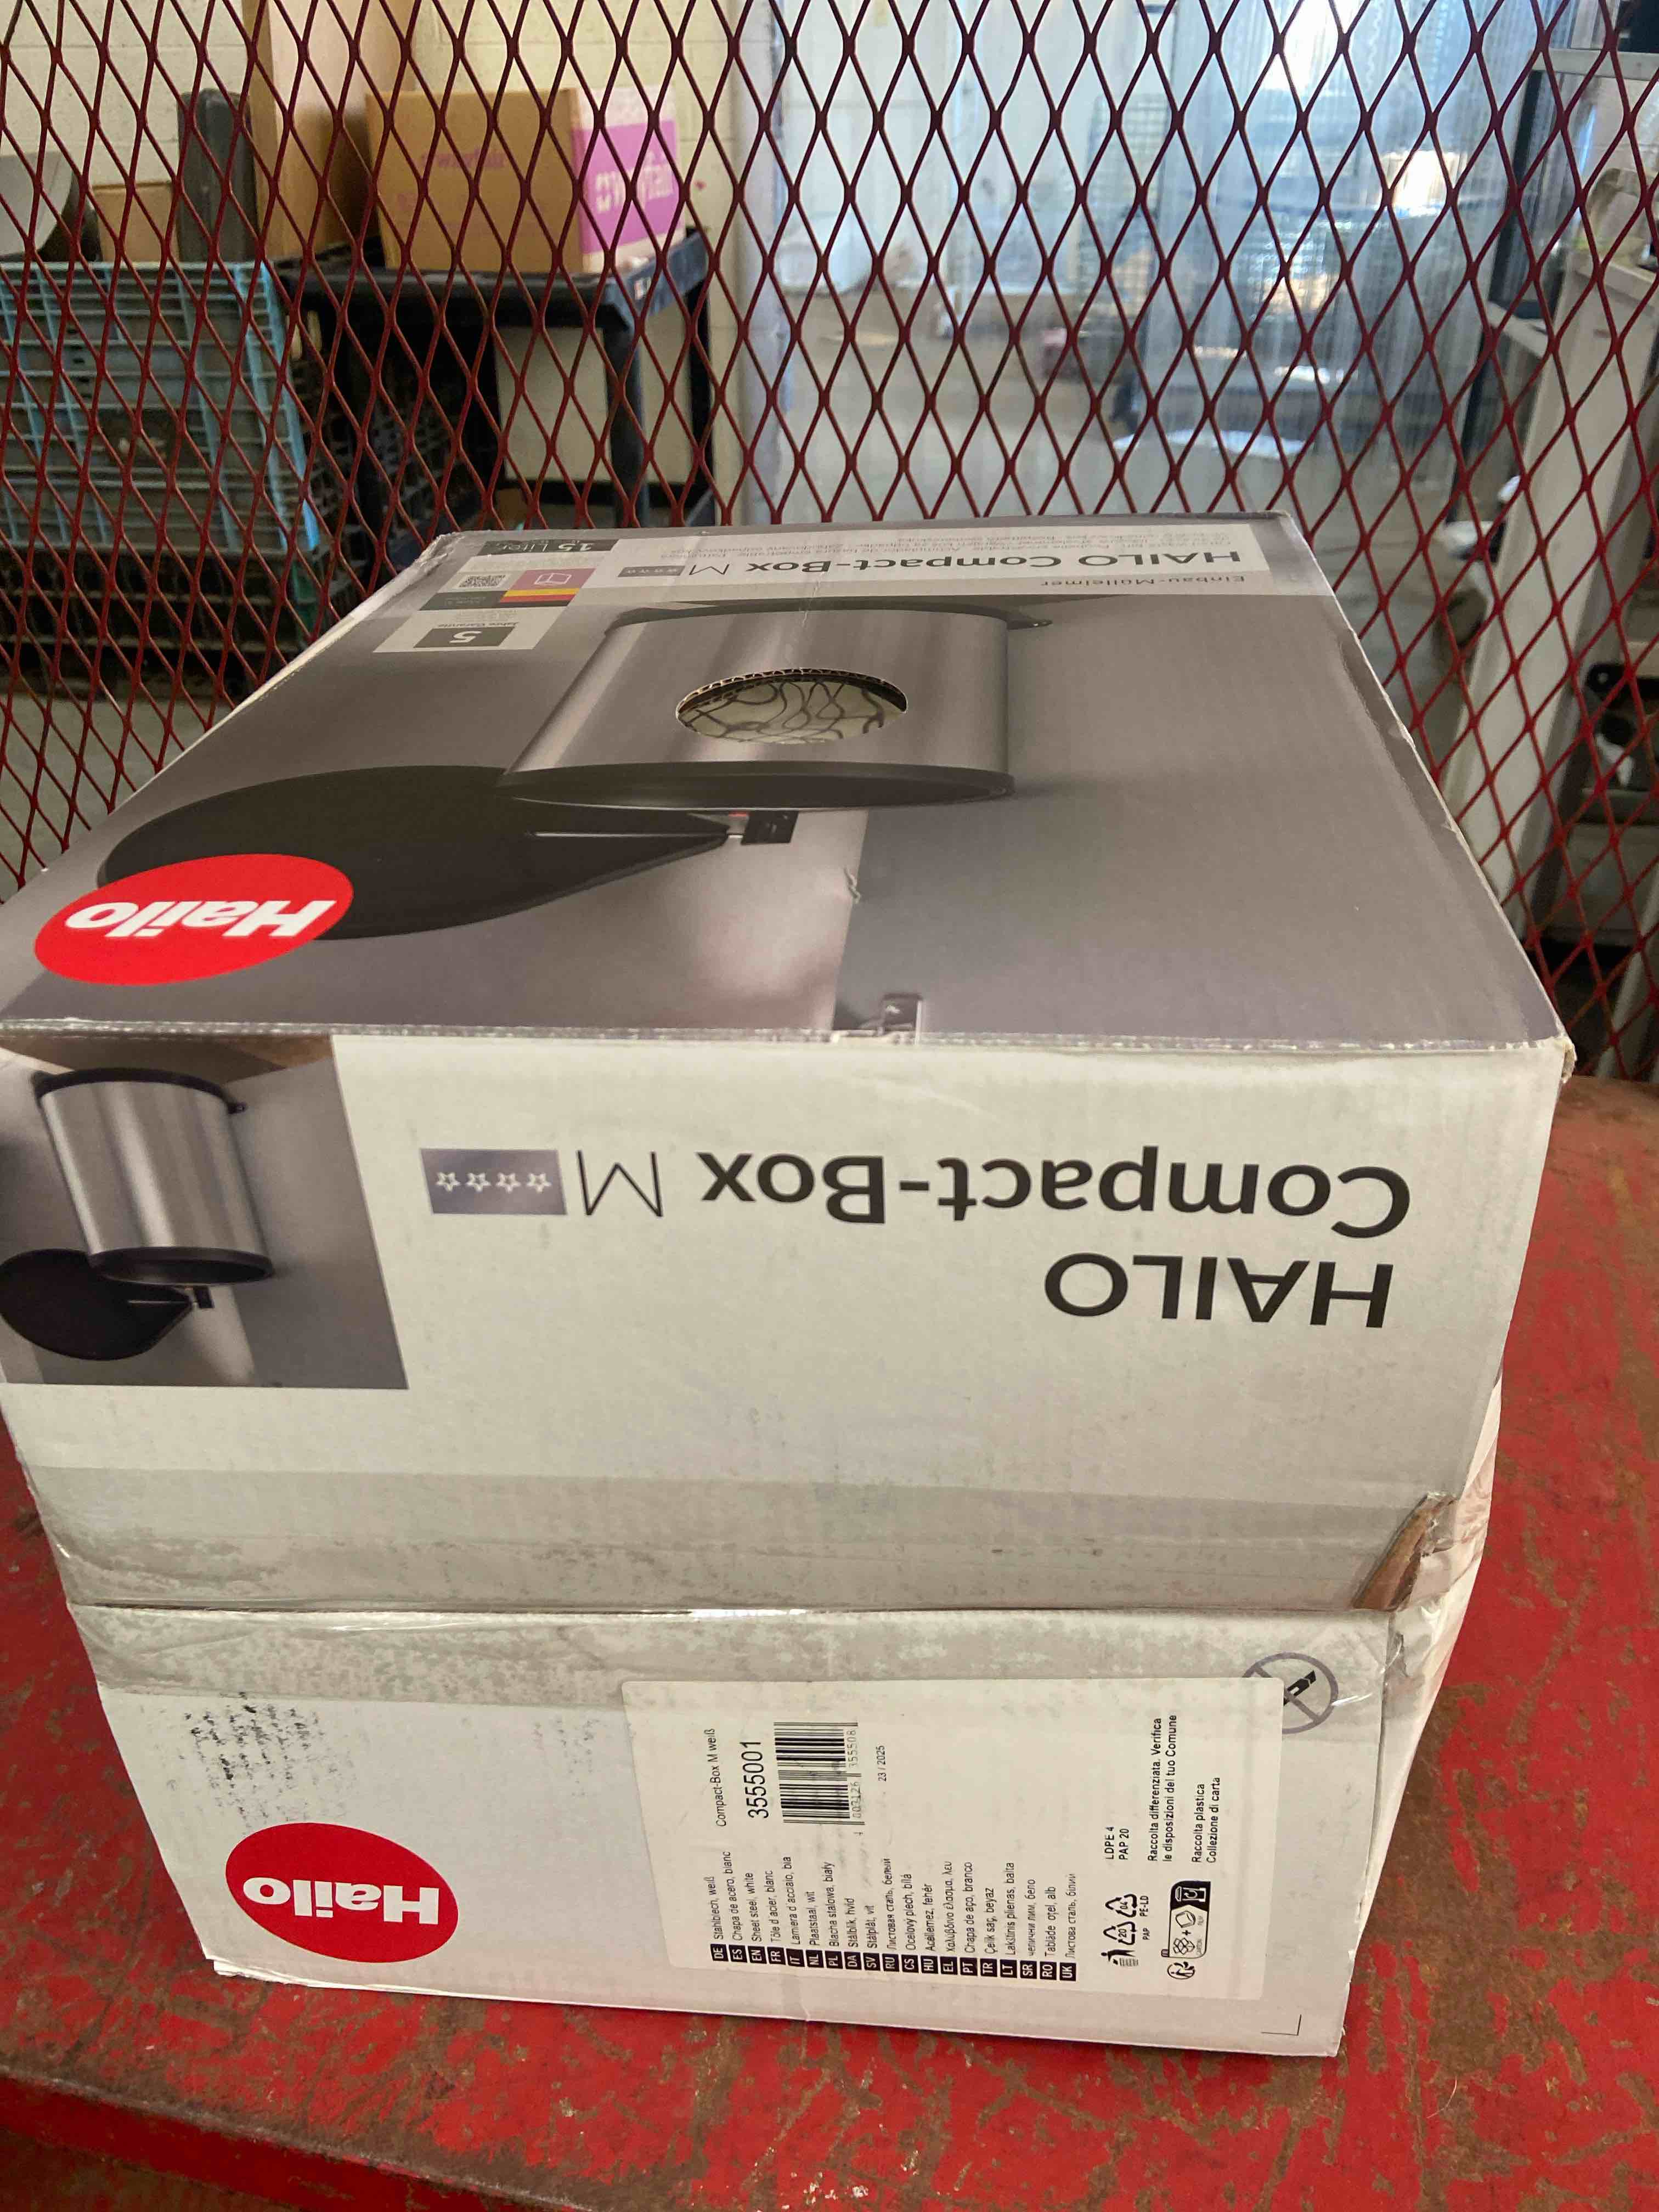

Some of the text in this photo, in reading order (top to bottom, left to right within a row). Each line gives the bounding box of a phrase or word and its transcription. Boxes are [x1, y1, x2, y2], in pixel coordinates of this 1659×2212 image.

[558, 543, 594, 552] 15
[688, 550, 1241, 576] HAILO Compact-Box M
[1040, 575, 1245, 587] Einbau-Mülleimer
[449, 631, 483, 644] 5
[65, 900, 336, 938] Hailo
[579, 1150, 1410, 1239] Compact-Box M
[1044, 1252, 1393, 1328] HAILO
[846, 1730, 859, 1767] 355508
[876, 1745, 885, 1765] 2025
[703, 1728, 727, 1826] Compact-Box M weiß
[739, 1741, 769, 1818] 3555001
[878, 1771, 887, 1781] 23
[1148, 1717, 1162, 1861] Raccolta differenziata. Verifica
[1163, 1714, 1177, 1861] le disposizioni del tuo Comune
[1192, 1783, 1206, 1862] Raccolta plastica
[1206, 1777, 1220, 1863] Collezione di carta
[1104, 1833, 1114, 1859] LDPE
[1119, 1828, 1129, 1860] PAP 20
[743, 1872, 755, 1894] white
[764, 1869, 775, 1892] blanc
[1003, 1862, 1014, 1883] balta
[805, 1891, 815, 1903] wit
[885, 1888, 895, 1911] сталь,
[922, 1883, 933, 1905] fehér
[984, 1887, 997, 1912] beyaz
[1024, 1878, 1036, 1899] бело
[1044, 1886, 1056, 1899] alb
[242, 1876, 439, 1925] Hailo
[722, 1851, 743, 1960] ES Chapa de acero, blanc
[844, 1897, 855, 1915] hvid
[865, 1904, 874, 1914] vit
[1003, 1886, 1017, 1919] plienas,
[1067, 1899, 1077, 1923] сталь,
[1139, 1895, 1149, 1917] PE-LD
[703, 1875, 724, 1959] DE Stahlblech, weiß
[822, 1861, 839, 1966] PL Blacha stalowa, biały
[900, 1874, 917, 1970] CS Ocelový plech, bílá
[962, 1861, 977, 1973] PT Chapa de aço, branco
[749, 1919, 762, 1942] Sheet
[769, 1926, 781, 1943] Tôle
[787, 1913, 800, 1945] Lamiera
[887, 1914, 897, 1950] Листовая
[1119, 1928, 1127, 1938] 20
[1142, 1927, 1150, 1940] PAP
[984, 1934, 998, 1954] Çelik
[1065, 1926, 1076, 1959] Листова
[751, 1949, 762, 1961] EN
[771, 1950, 782, 1962] FR
[790, 1956, 800, 1964] IT
[810, 1954, 820, 1965] NL
[847, 1955, 857, 1967] DA
[866, 1956, 877, 1968] SV
[885, 1957, 895, 1969] RU
[924, 1959, 934, 1971] HU
[943, 1961, 953, 1972] EL
[983, 1962, 992, 1974] TR
[1003, 1963, 1013, 1974] LT
[1023, 1963, 1034, 1976] SR
[1042, 1964, 1053, 1977] RO
[1062, 1966, 1073, 1978] UK
